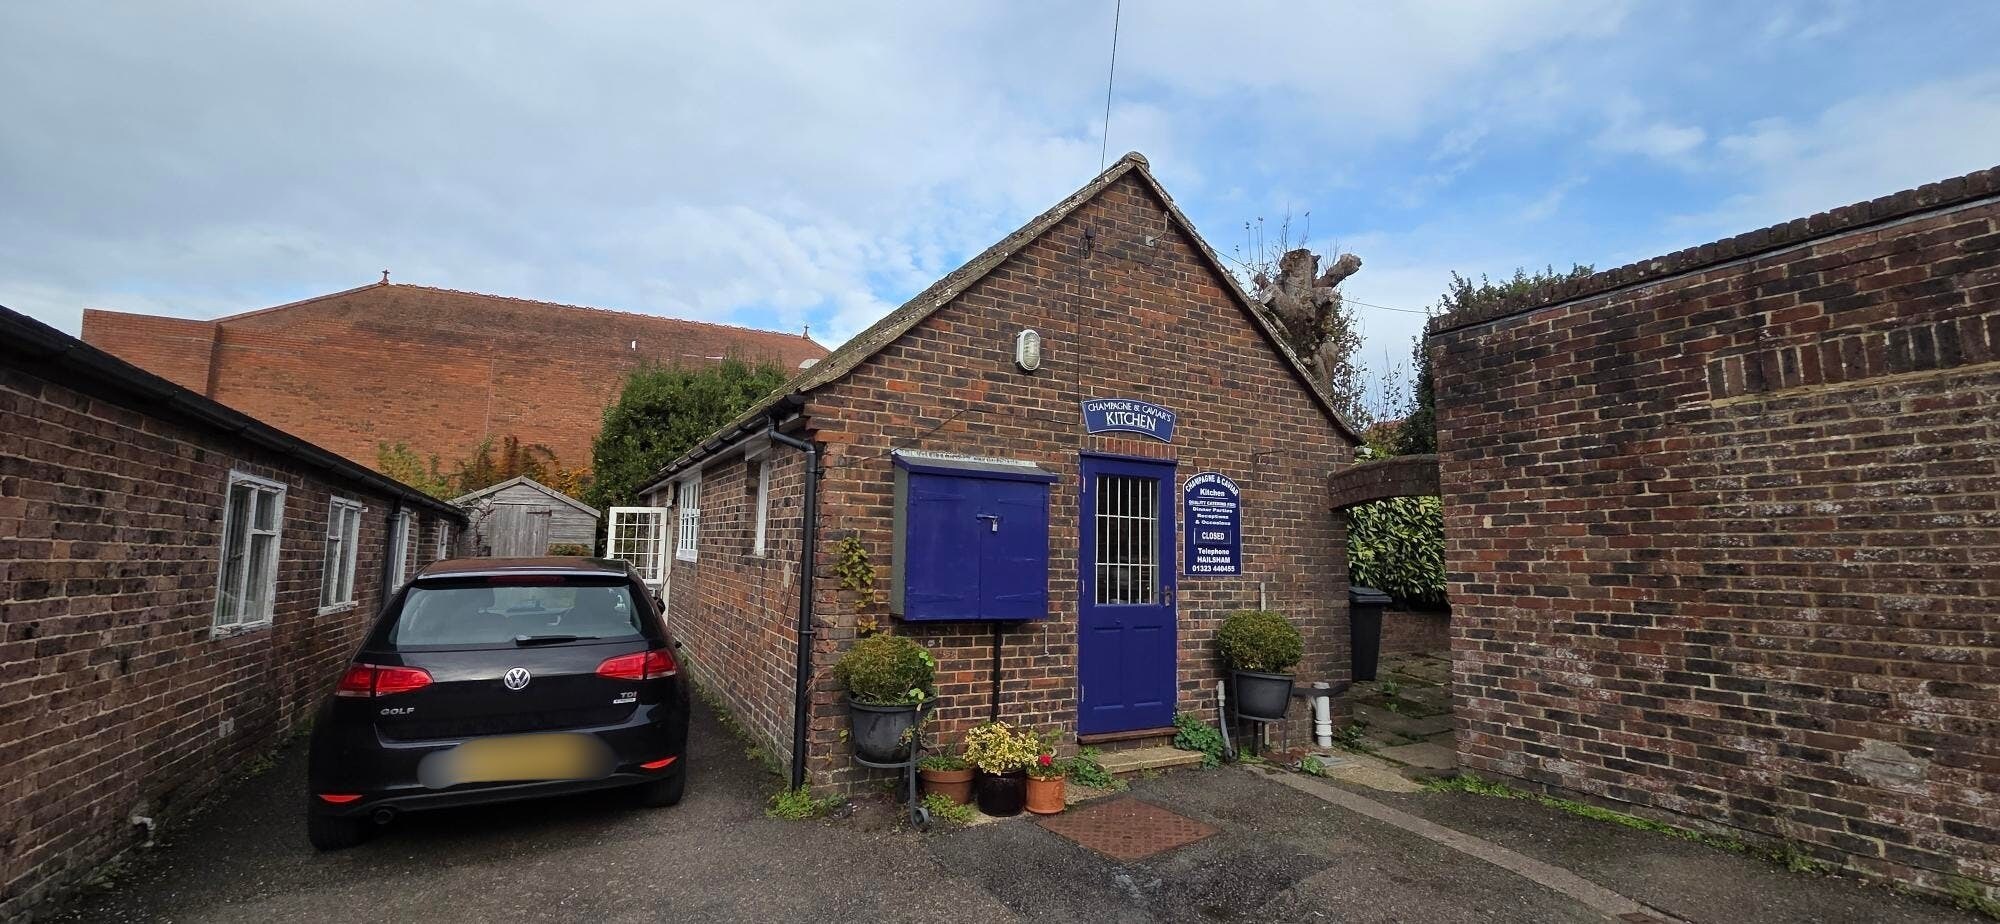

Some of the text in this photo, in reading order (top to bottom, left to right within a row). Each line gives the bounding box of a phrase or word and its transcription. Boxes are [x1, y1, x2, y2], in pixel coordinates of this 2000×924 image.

[1088, 402, 1132, 412] CHAMPAGNE
[1142, 405, 1172, 422] CAVIAR'S
[1105, 411, 1156, 431] KITCHEN
[1185, 475, 1215, 492] CHAMPAGNE
[1221, 478, 1239, 496] CAVIAR
[1200, 488, 1225, 497] Kitchen
[1202, 532, 1225, 540] CLOSED
[1197, 547, 1230, 556] Telephone
[1197, 556, 1231, 564] HAILSHAM
[380, 707, 415, 715] GOLF
